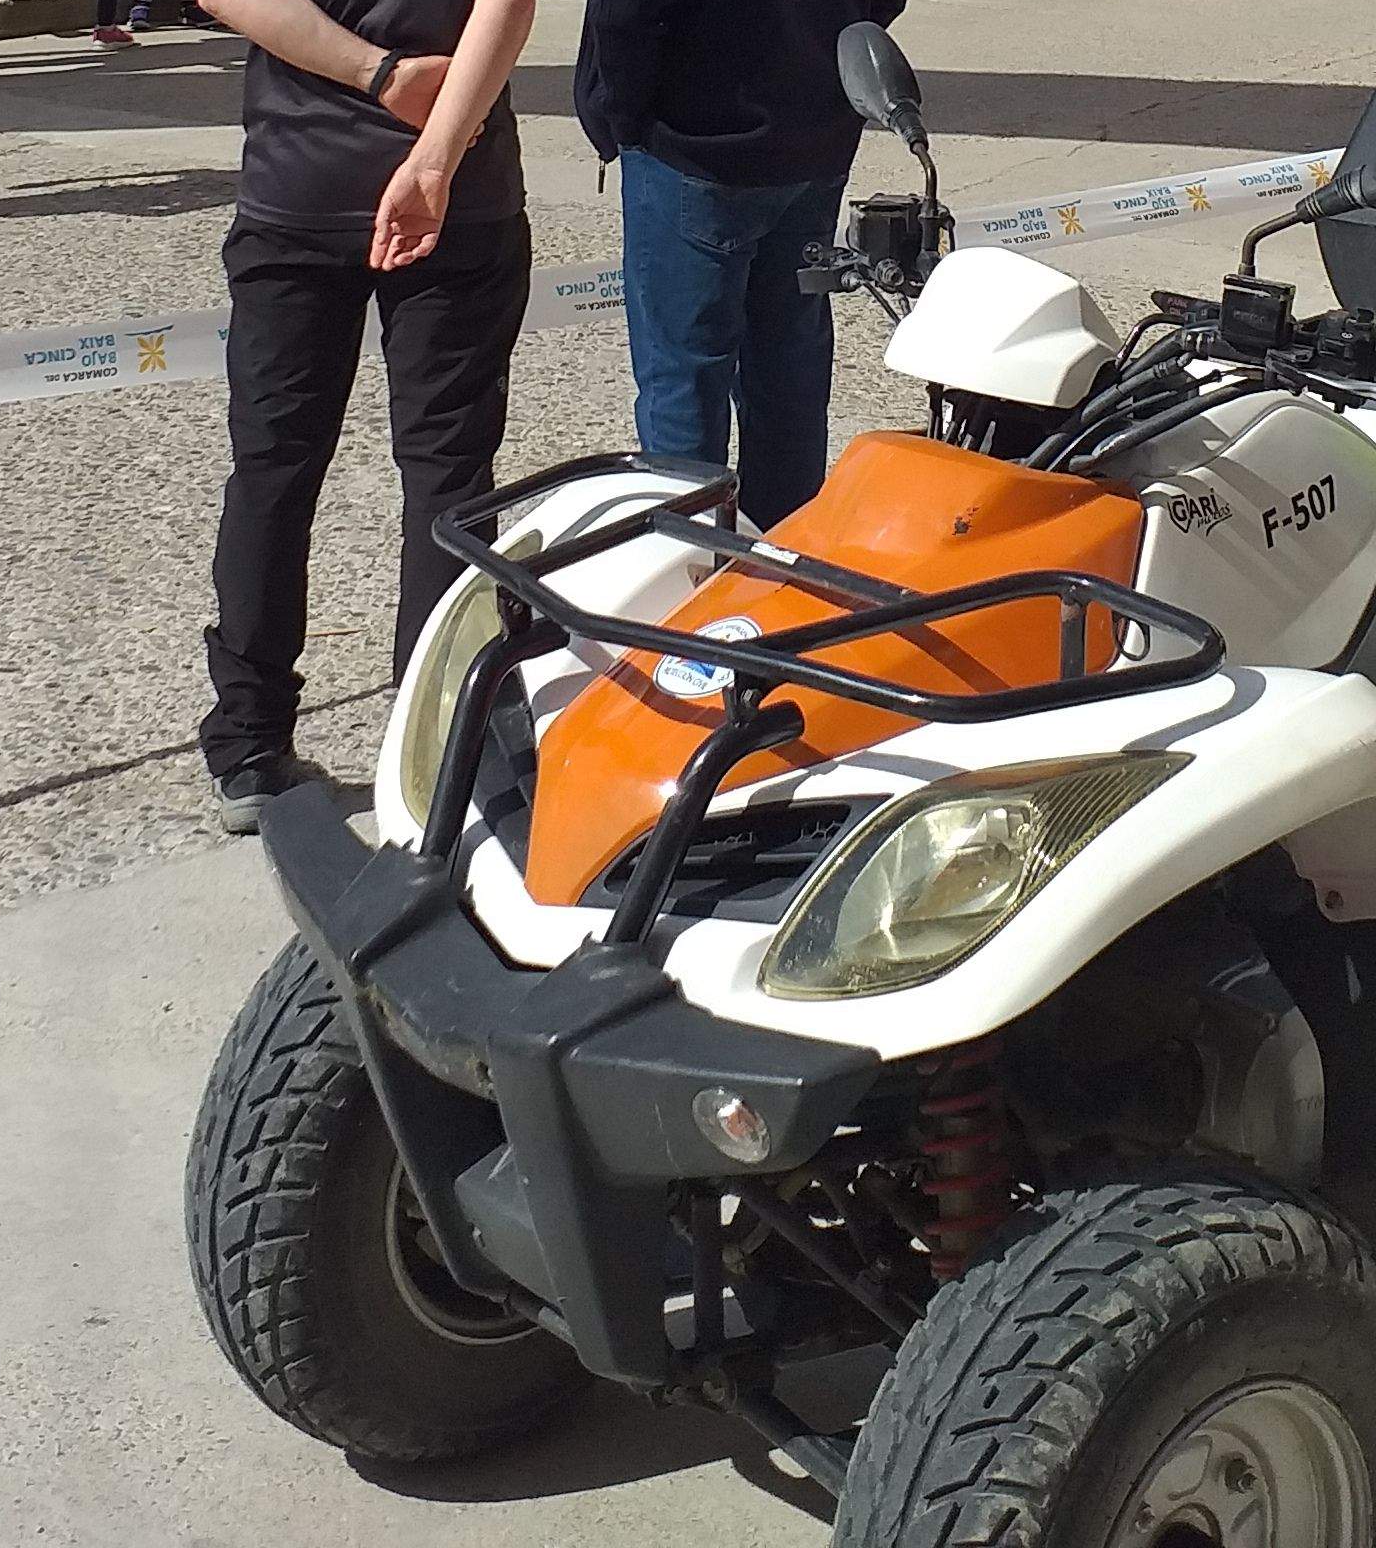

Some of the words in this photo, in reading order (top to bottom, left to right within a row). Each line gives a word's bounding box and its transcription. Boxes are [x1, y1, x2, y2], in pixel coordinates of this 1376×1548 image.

[983, 218, 1018, 232] CINCA
[556, 281, 596, 296] CINCA
[588, 298, 626, 311] OMARCA
[79, 334, 115, 349] BAIX
[25, 348, 76, 365] CINCA
[82, 351, 117, 366] BAJO
[63, 367, 118, 382] COMARCA
[1262, 474, 1335, 548] F-507
